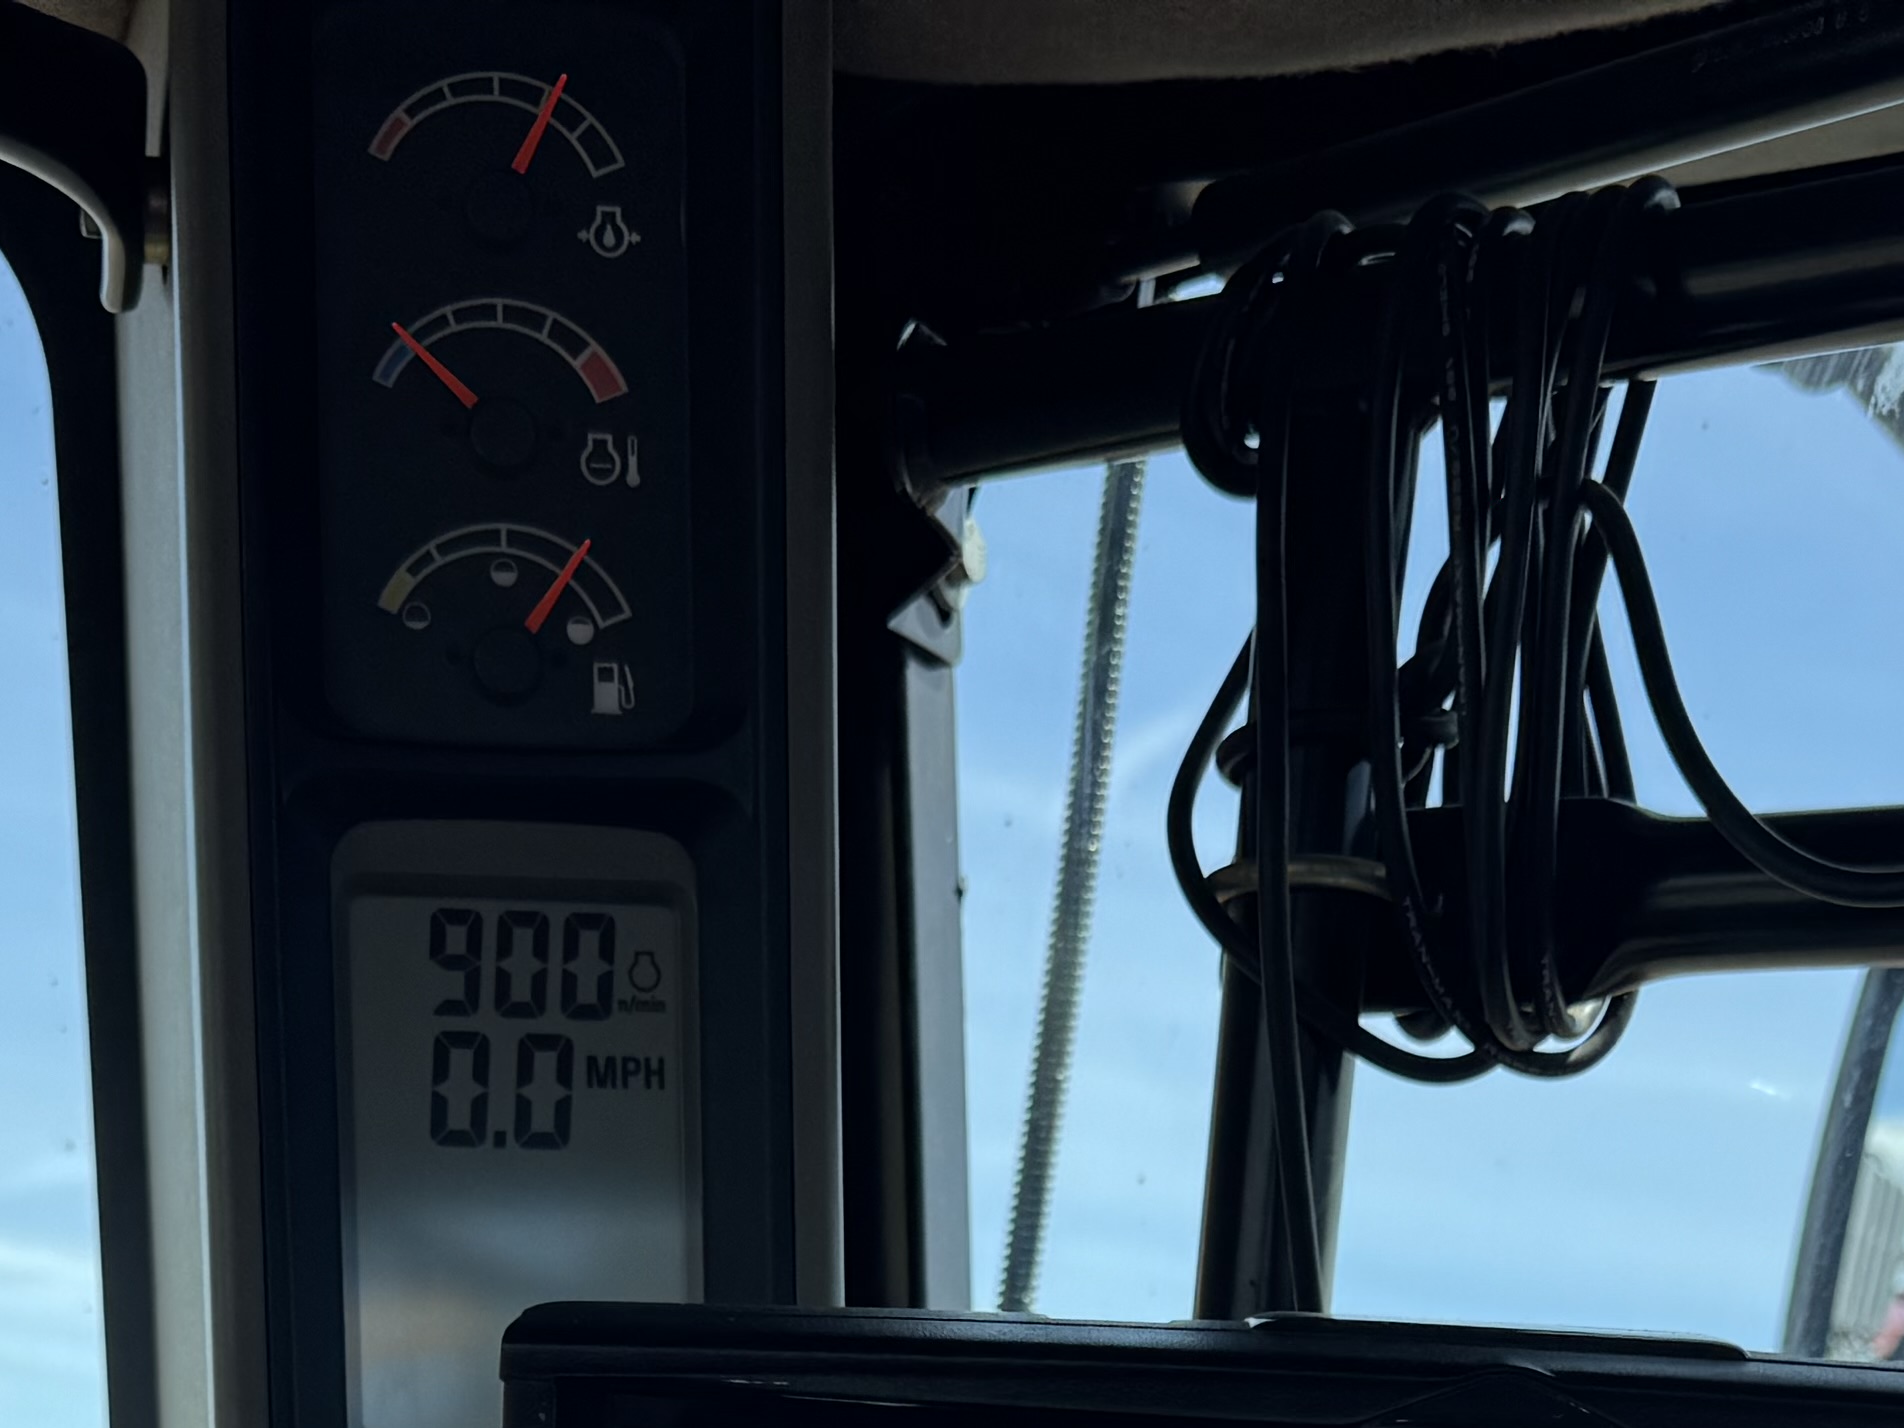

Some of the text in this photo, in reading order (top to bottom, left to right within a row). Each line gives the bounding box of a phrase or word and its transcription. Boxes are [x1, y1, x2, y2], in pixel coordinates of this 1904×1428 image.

[429, 907, 615, 1021] 900
[430, 1030, 666, 1150] 0.0 MPH
